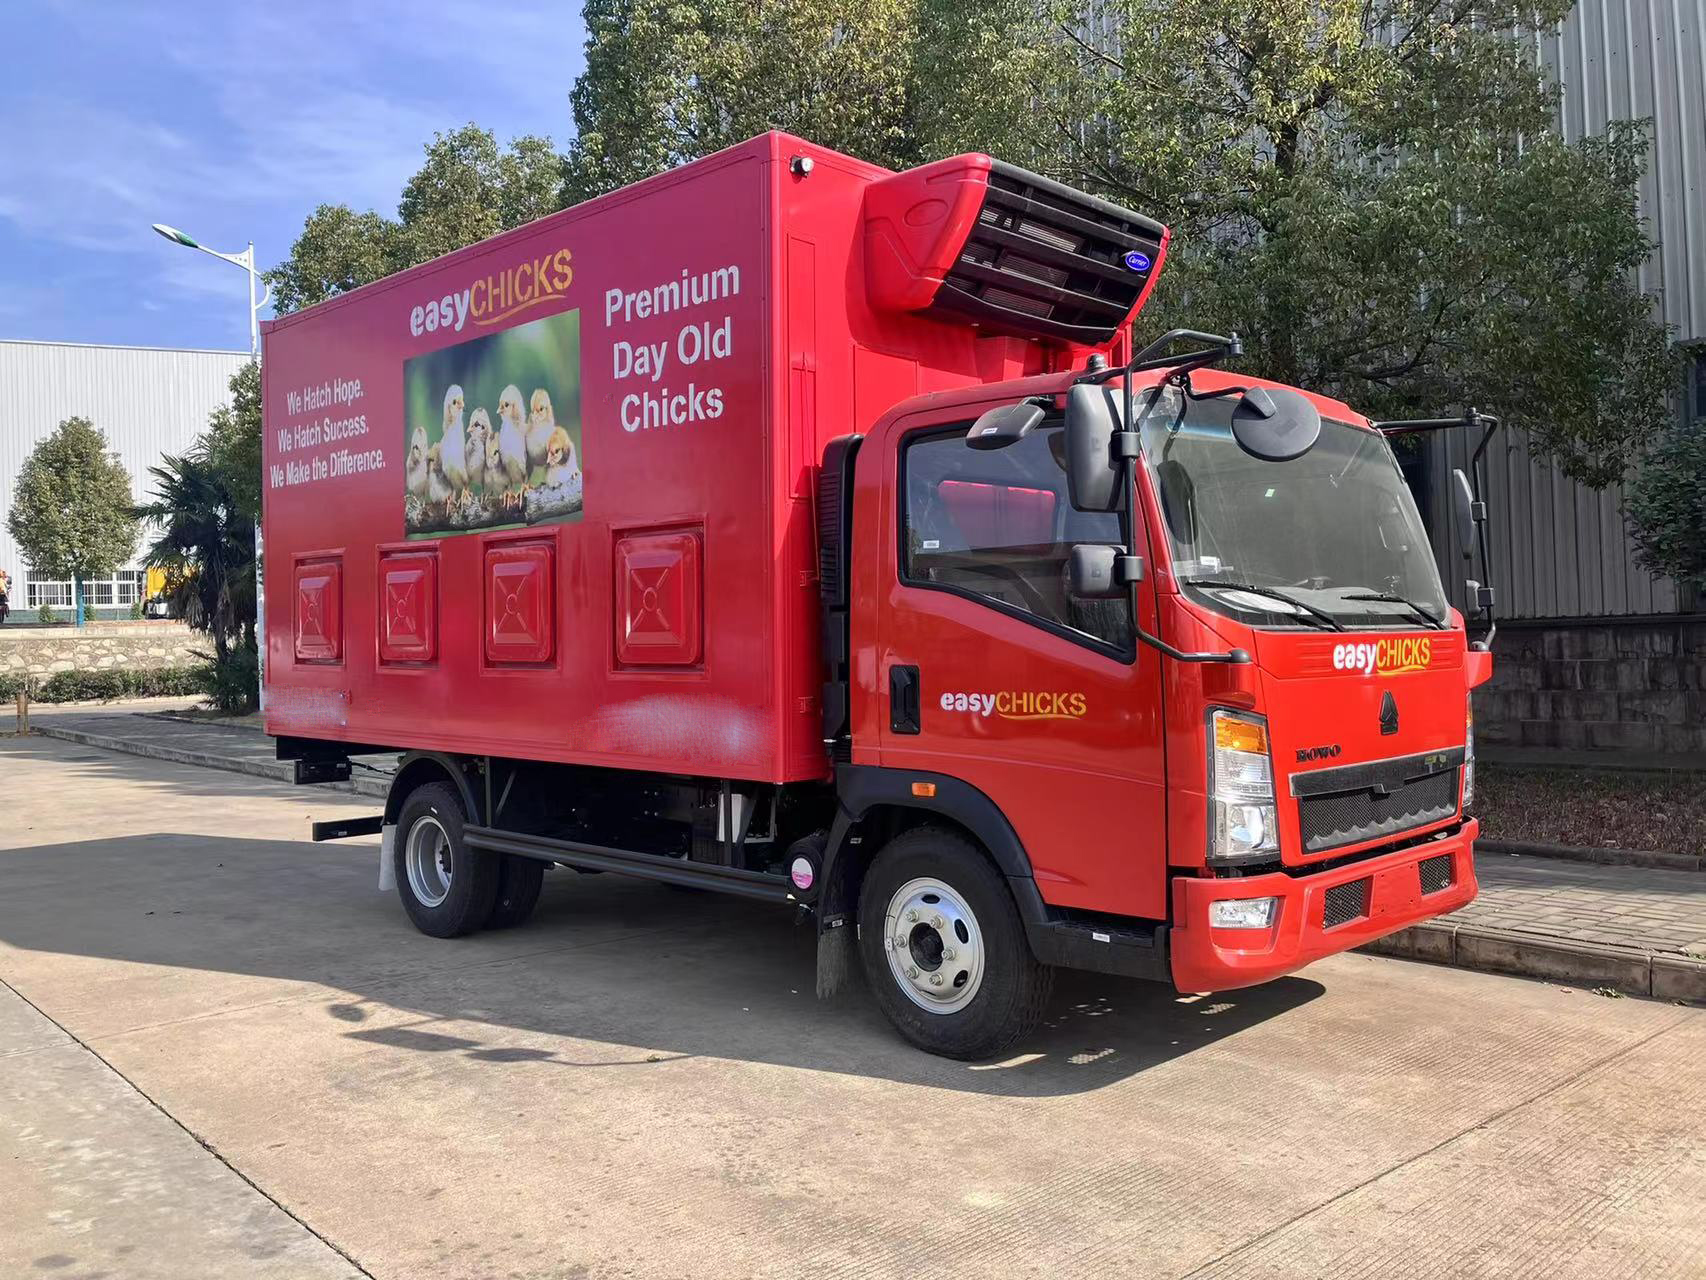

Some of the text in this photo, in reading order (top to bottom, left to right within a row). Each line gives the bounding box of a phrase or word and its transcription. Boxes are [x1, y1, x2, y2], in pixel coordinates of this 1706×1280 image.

[410, 249, 573, 337] easyCHICKS
[605, 265, 740, 327] Premium
[613, 316, 732, 382] Day Old
[287, 378, 364, 416] We Hatch Hope.
[620, 383, 725, 433] Chicks
[278, 415, 370, 453] We Hatch Success.
[270, 449, 386, 489] We Make the Difference.
[1333, 637, 1430, 675] easyCHICKS
[940, 691, 1088, 717] easyCHICKS
